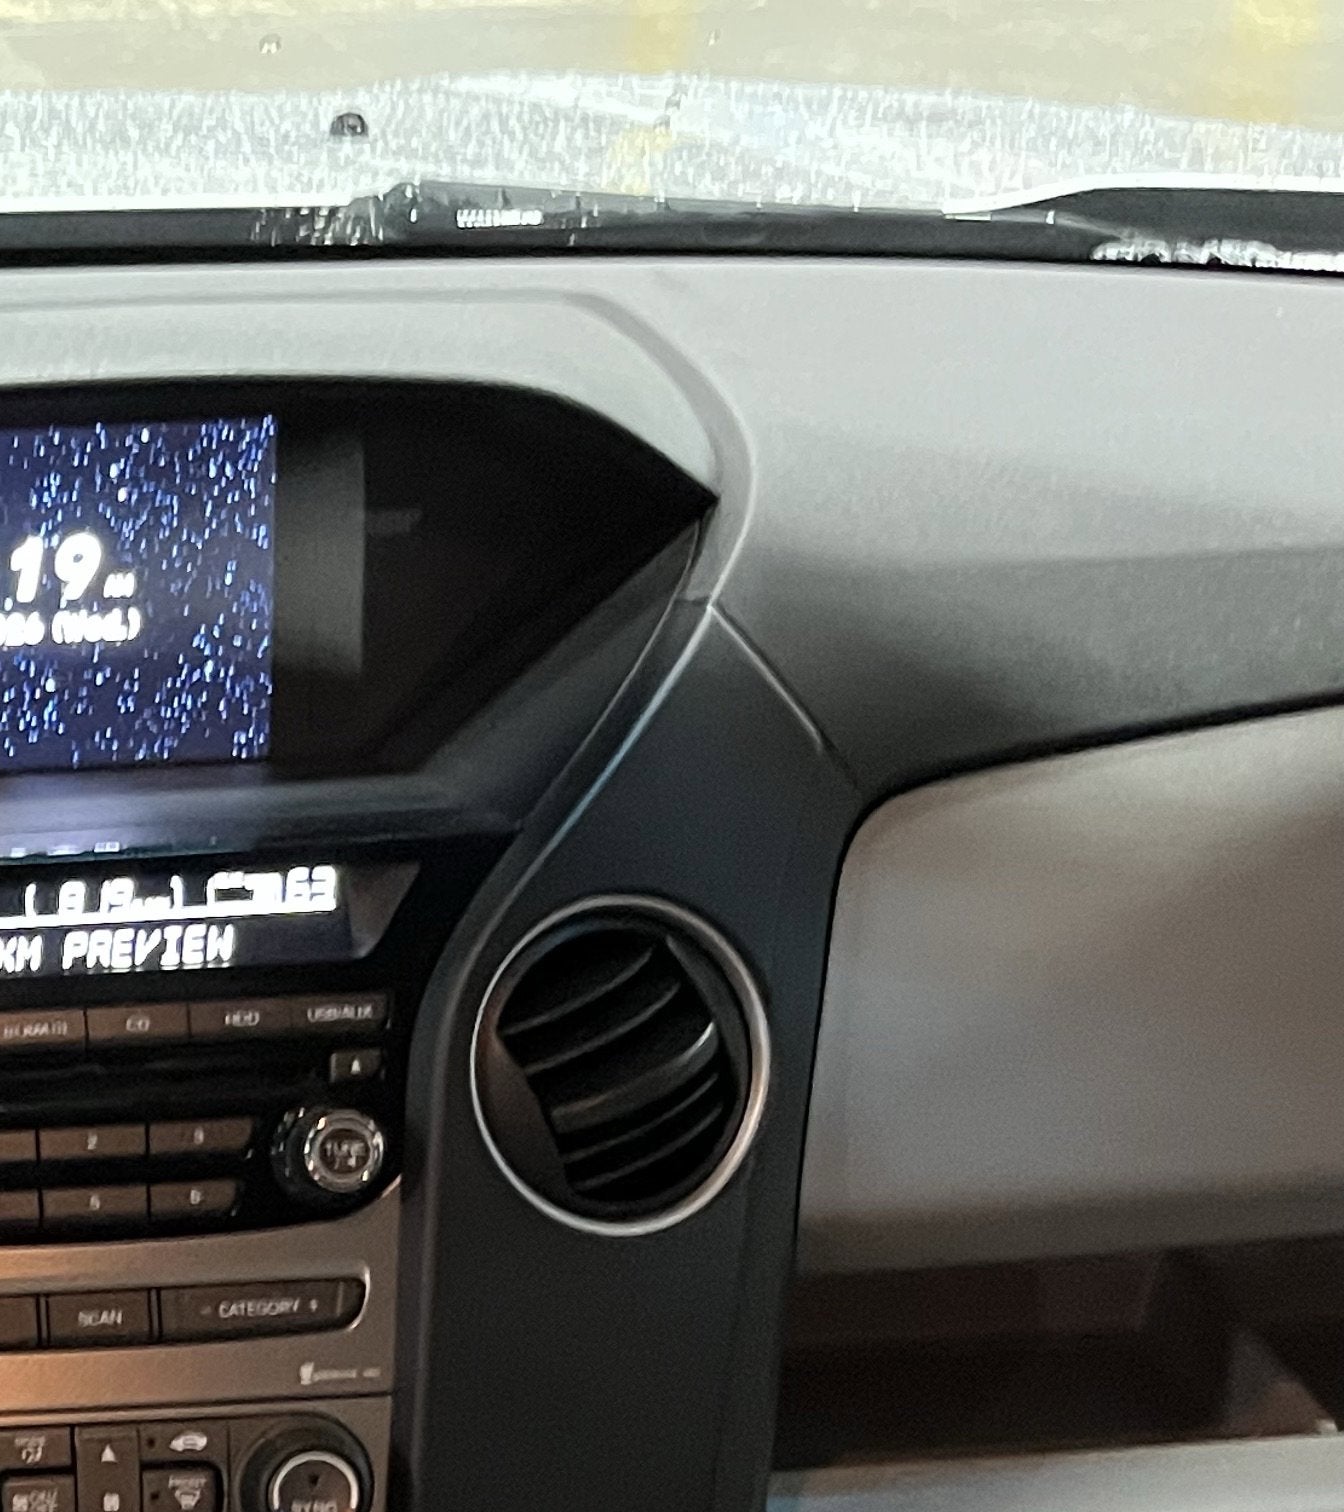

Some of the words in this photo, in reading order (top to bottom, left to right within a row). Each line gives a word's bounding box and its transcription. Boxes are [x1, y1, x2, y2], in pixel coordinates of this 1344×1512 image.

[62, 923, 235, 971] PREVIEW
[218, 1298, 300, 1318] CATEGORY
[78, 1311, 123, 1327] SCAN
